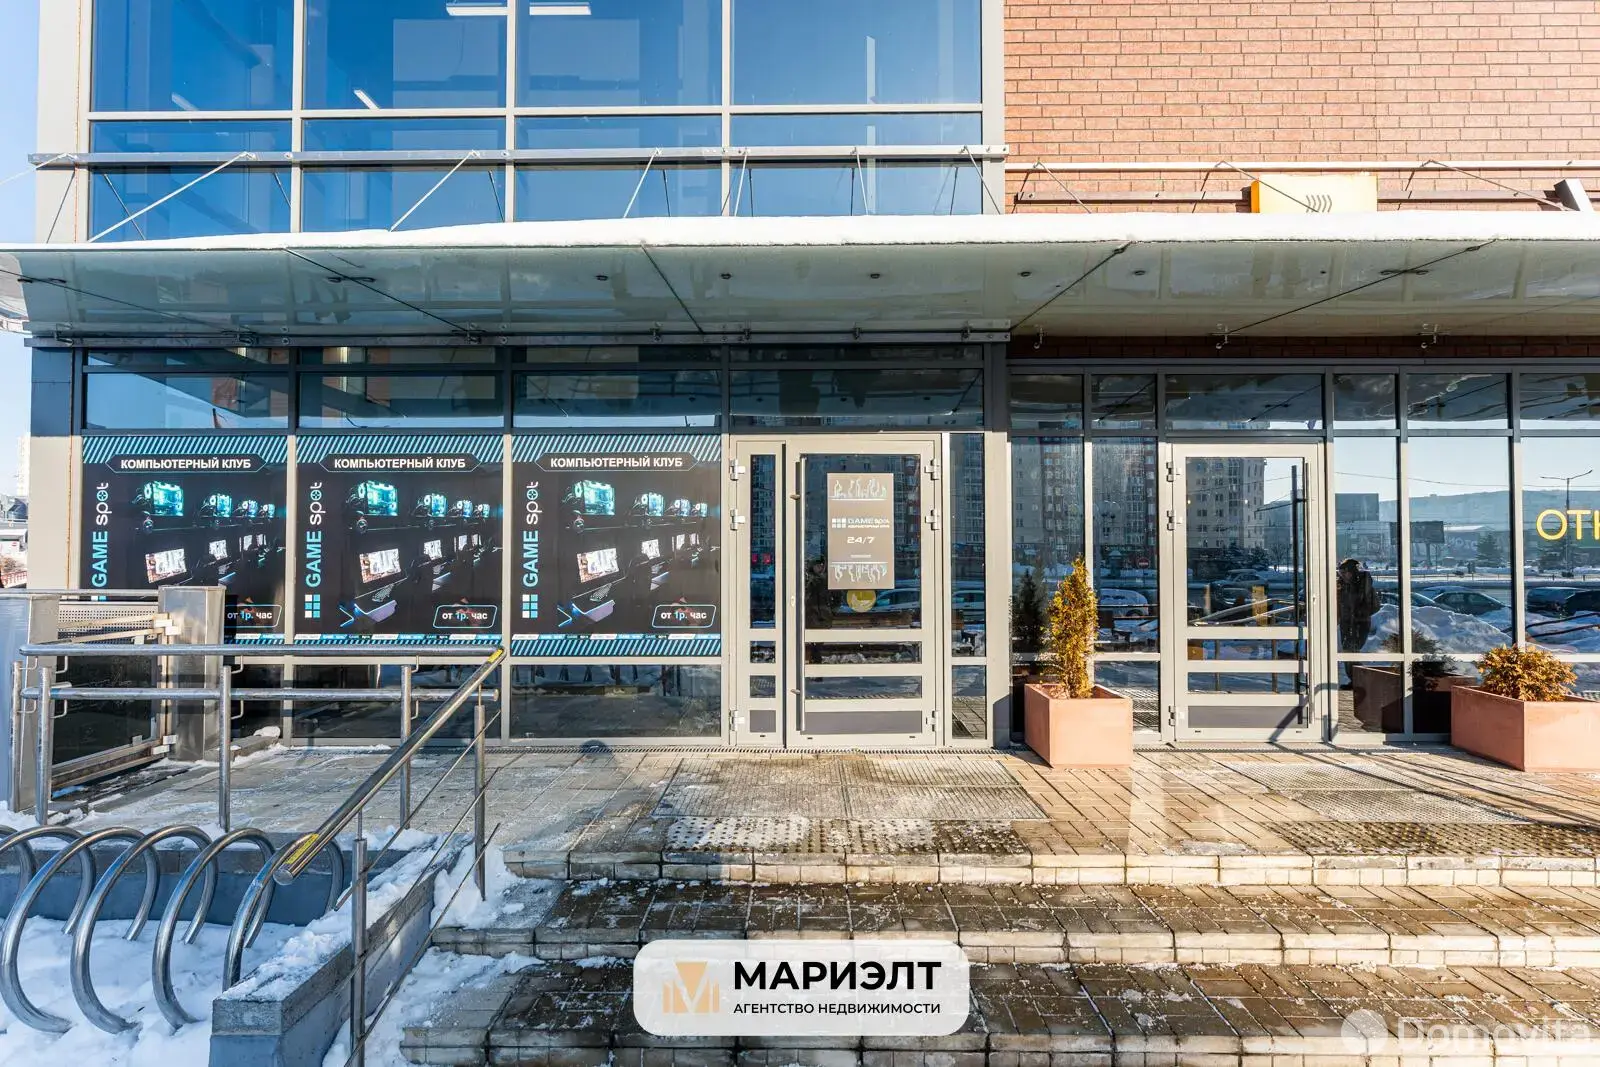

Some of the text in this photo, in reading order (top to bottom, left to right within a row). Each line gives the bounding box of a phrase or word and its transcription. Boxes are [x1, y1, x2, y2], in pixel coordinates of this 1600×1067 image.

[120, 458, 252, 470] КОМПЬЮТЕРНЫЙ КЛУБ
[334, 457, 466, 469] КОМПЬЮТЕРНЫЙ КЛУБ
[550, 456, 683, 468] КОМПЬЮТЕРНЫЙ КЛУБ
[847, 536, 875, 544] 24/7
[91, 531, 109, 588] GAME
[305, 530, 322, 588] GAME
[522, 530, 539, 588] GAME
[442, 612, 452, 620] от
[471, 612, 488, 620] час
[660, 612, 671, 620] от
[689, 612, 707, 620] час
